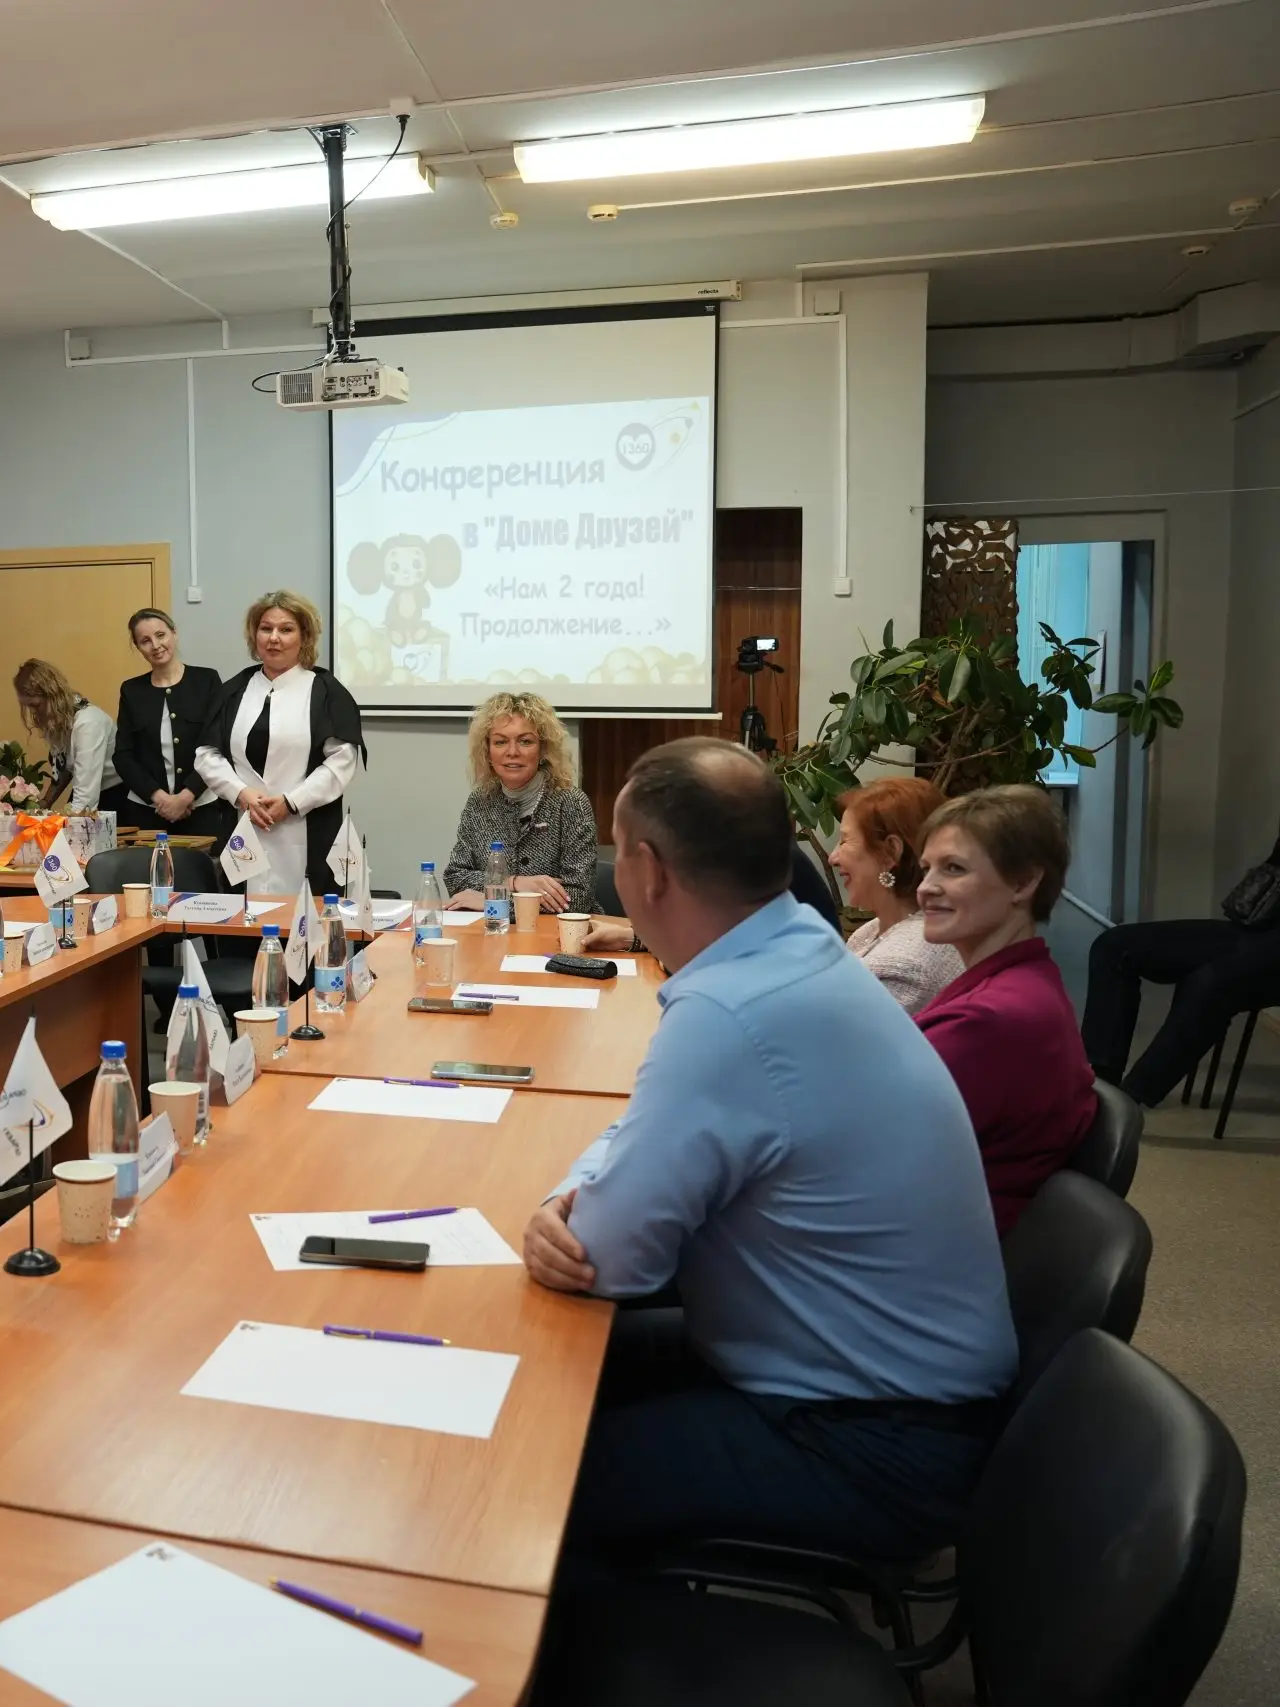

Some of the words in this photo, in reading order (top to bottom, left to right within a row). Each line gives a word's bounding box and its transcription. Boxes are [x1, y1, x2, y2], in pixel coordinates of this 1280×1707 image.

[622, 442, 650, 455] 1360
[380, 458, 606, 500] Конференция
[462, 521, 479, 549] в
[484, 514, 569, 552] "Доме
[575, 508, 693, 550] Друзей"
[484, 576, 548, 600] «Нам
[559, 574, 573, 599] 2
[584, 573, 645, 601] года!
